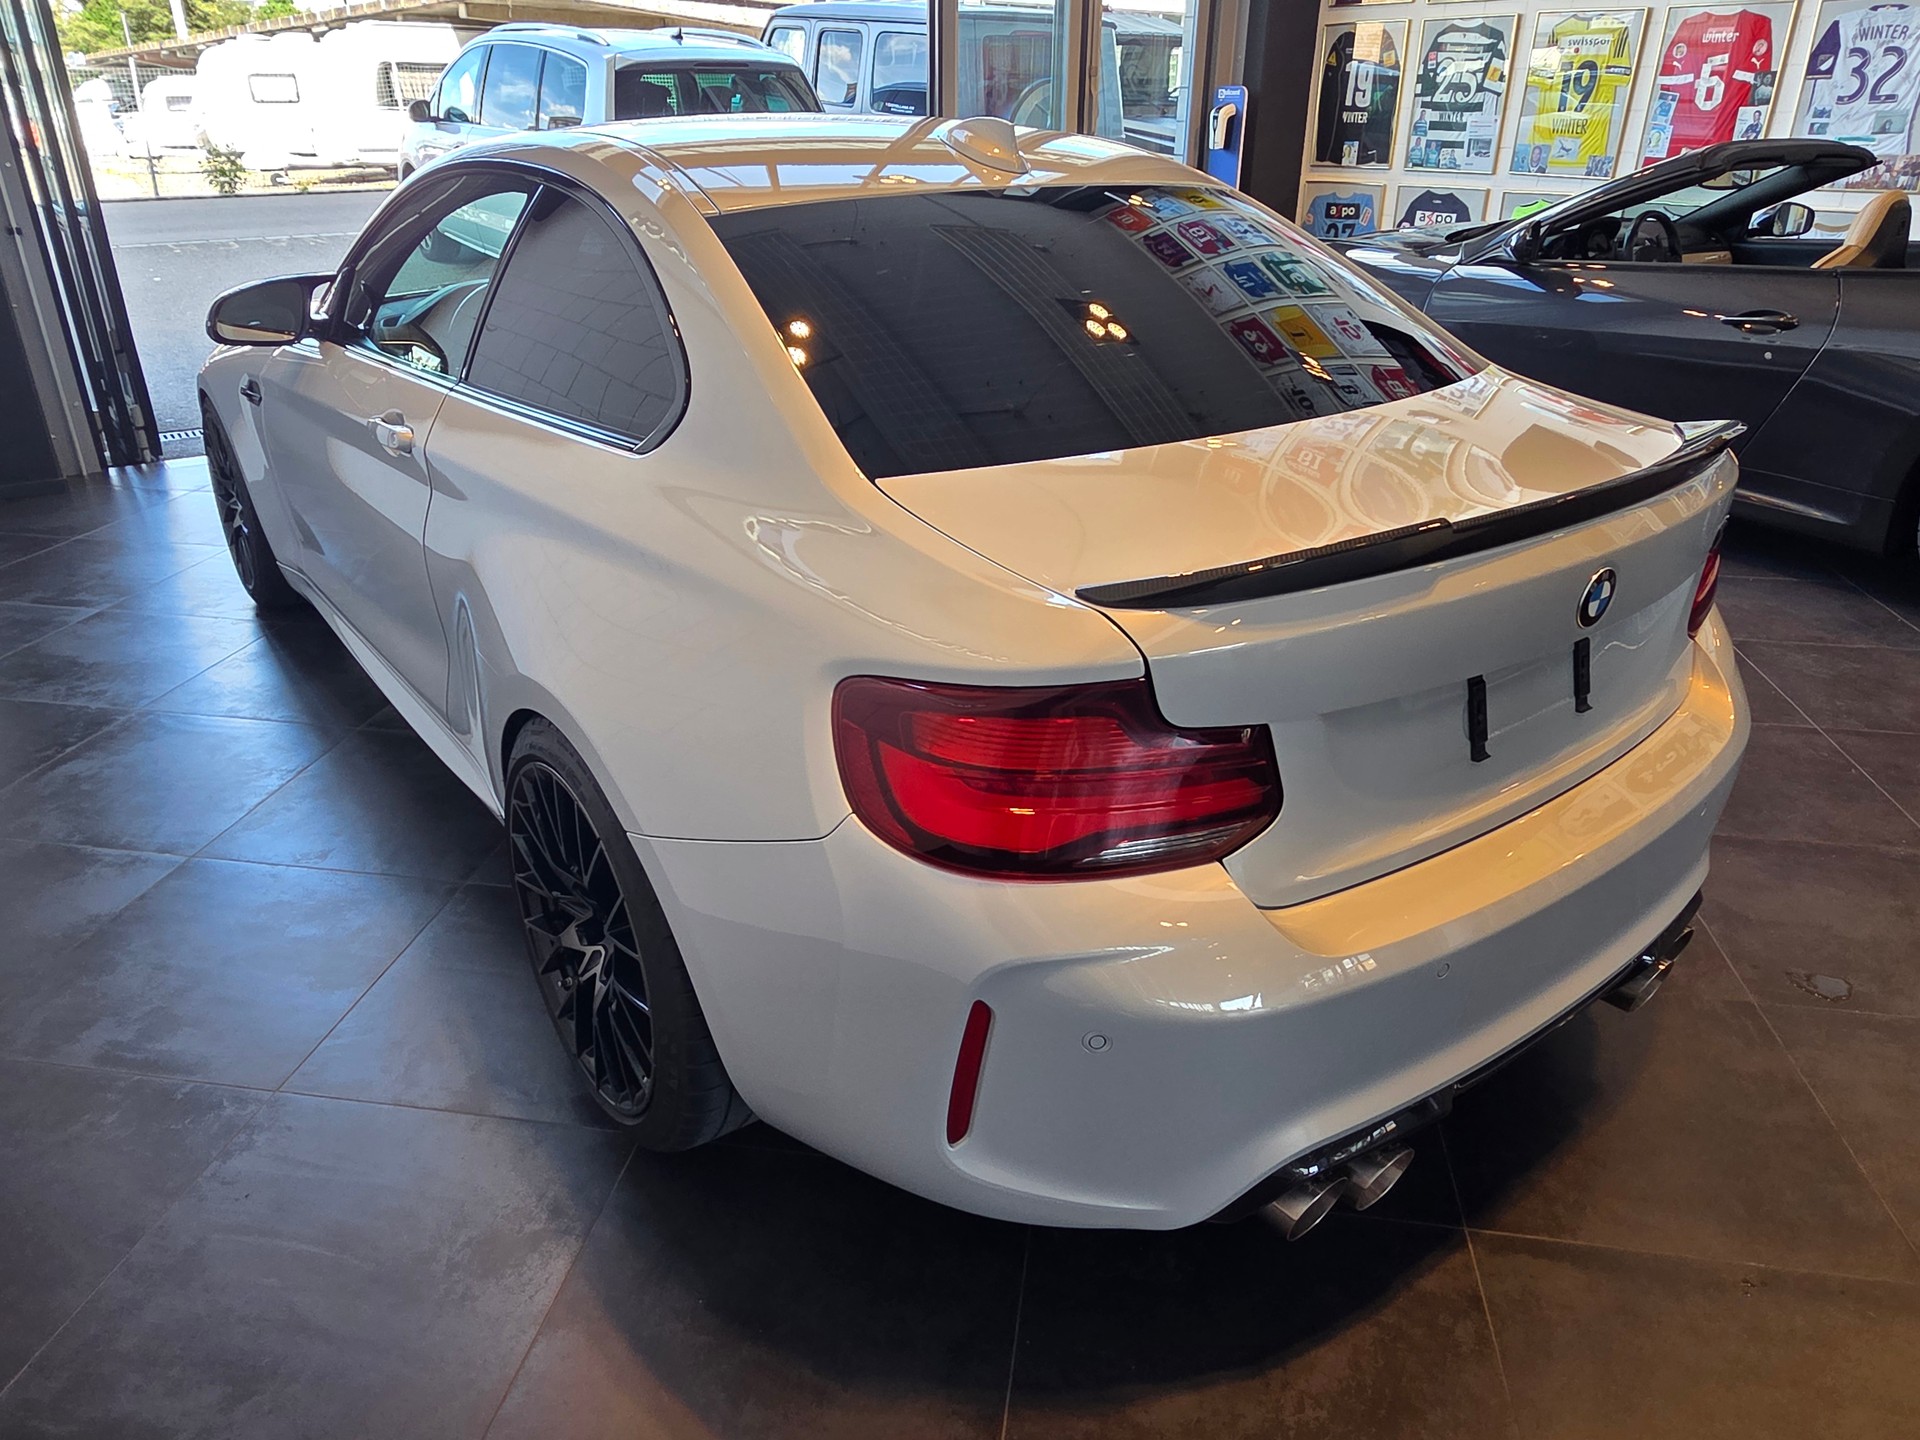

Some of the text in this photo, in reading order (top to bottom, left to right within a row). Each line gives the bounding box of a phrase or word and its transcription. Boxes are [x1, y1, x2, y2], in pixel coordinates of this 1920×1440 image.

[1702, 31, 1740, 43] winter
[1859, 23, 1909, 41] WINTER
[1345, 60, 1375, 108] 19
[1431, 55, 1490, 103] 25
[1557, 60, 1598, 112] 19
[1694, 53, 1729, 111] 6
[1835, 45, 1908, 105] 32
[1552, 118, 1588, 134] WINTER
